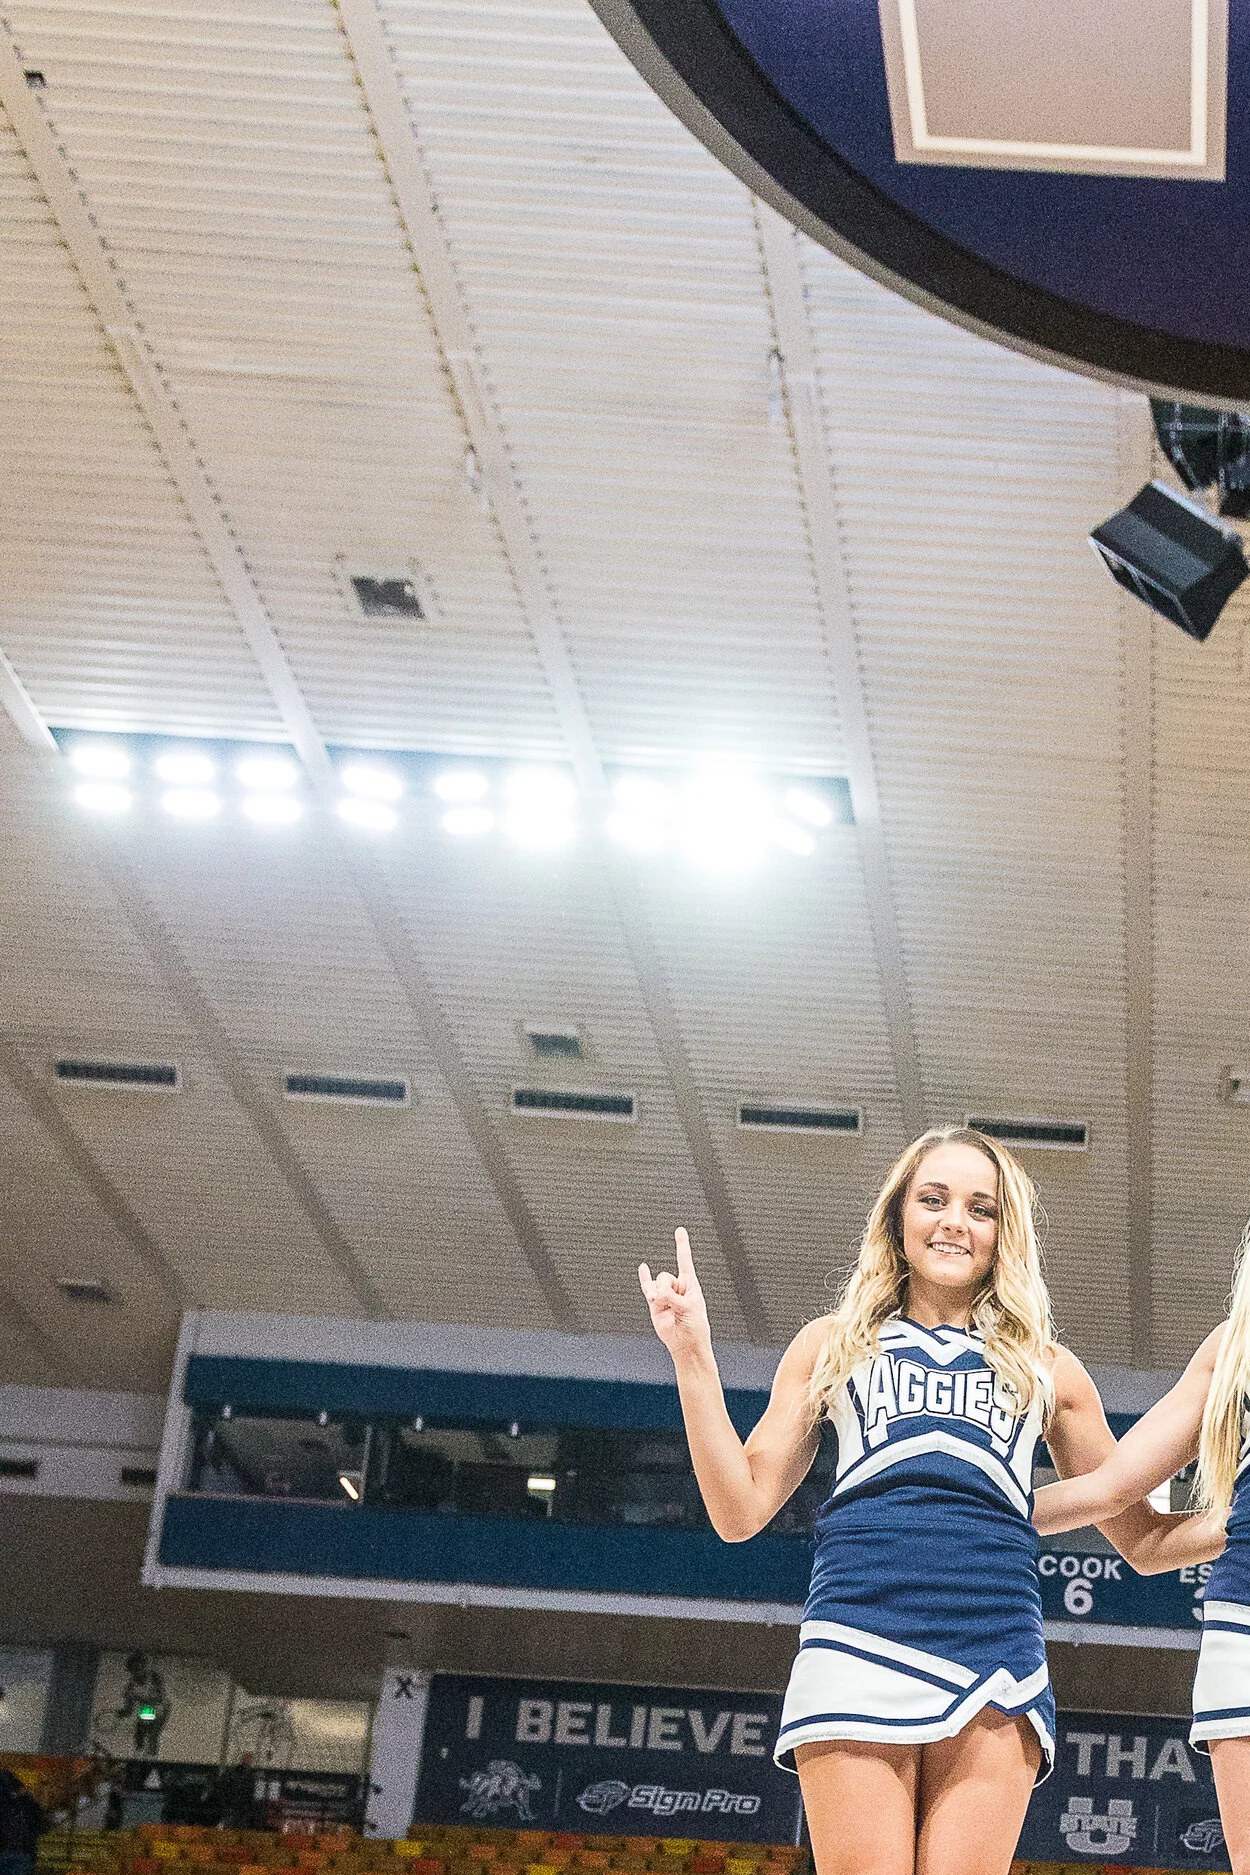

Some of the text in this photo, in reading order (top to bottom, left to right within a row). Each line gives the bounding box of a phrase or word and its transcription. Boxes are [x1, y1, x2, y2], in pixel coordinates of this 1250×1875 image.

[865, 1353, 1022, 1444] AGGIES
[1038, 1554, 1123, 1581] COOK
[1063, 1577, 1094, 1616] 6
[395, 1675, 413, 1699] X
[466, 1696, 770, 1757] I BELIEVE
[628, 1785, 762, 1816] Sign Pro
